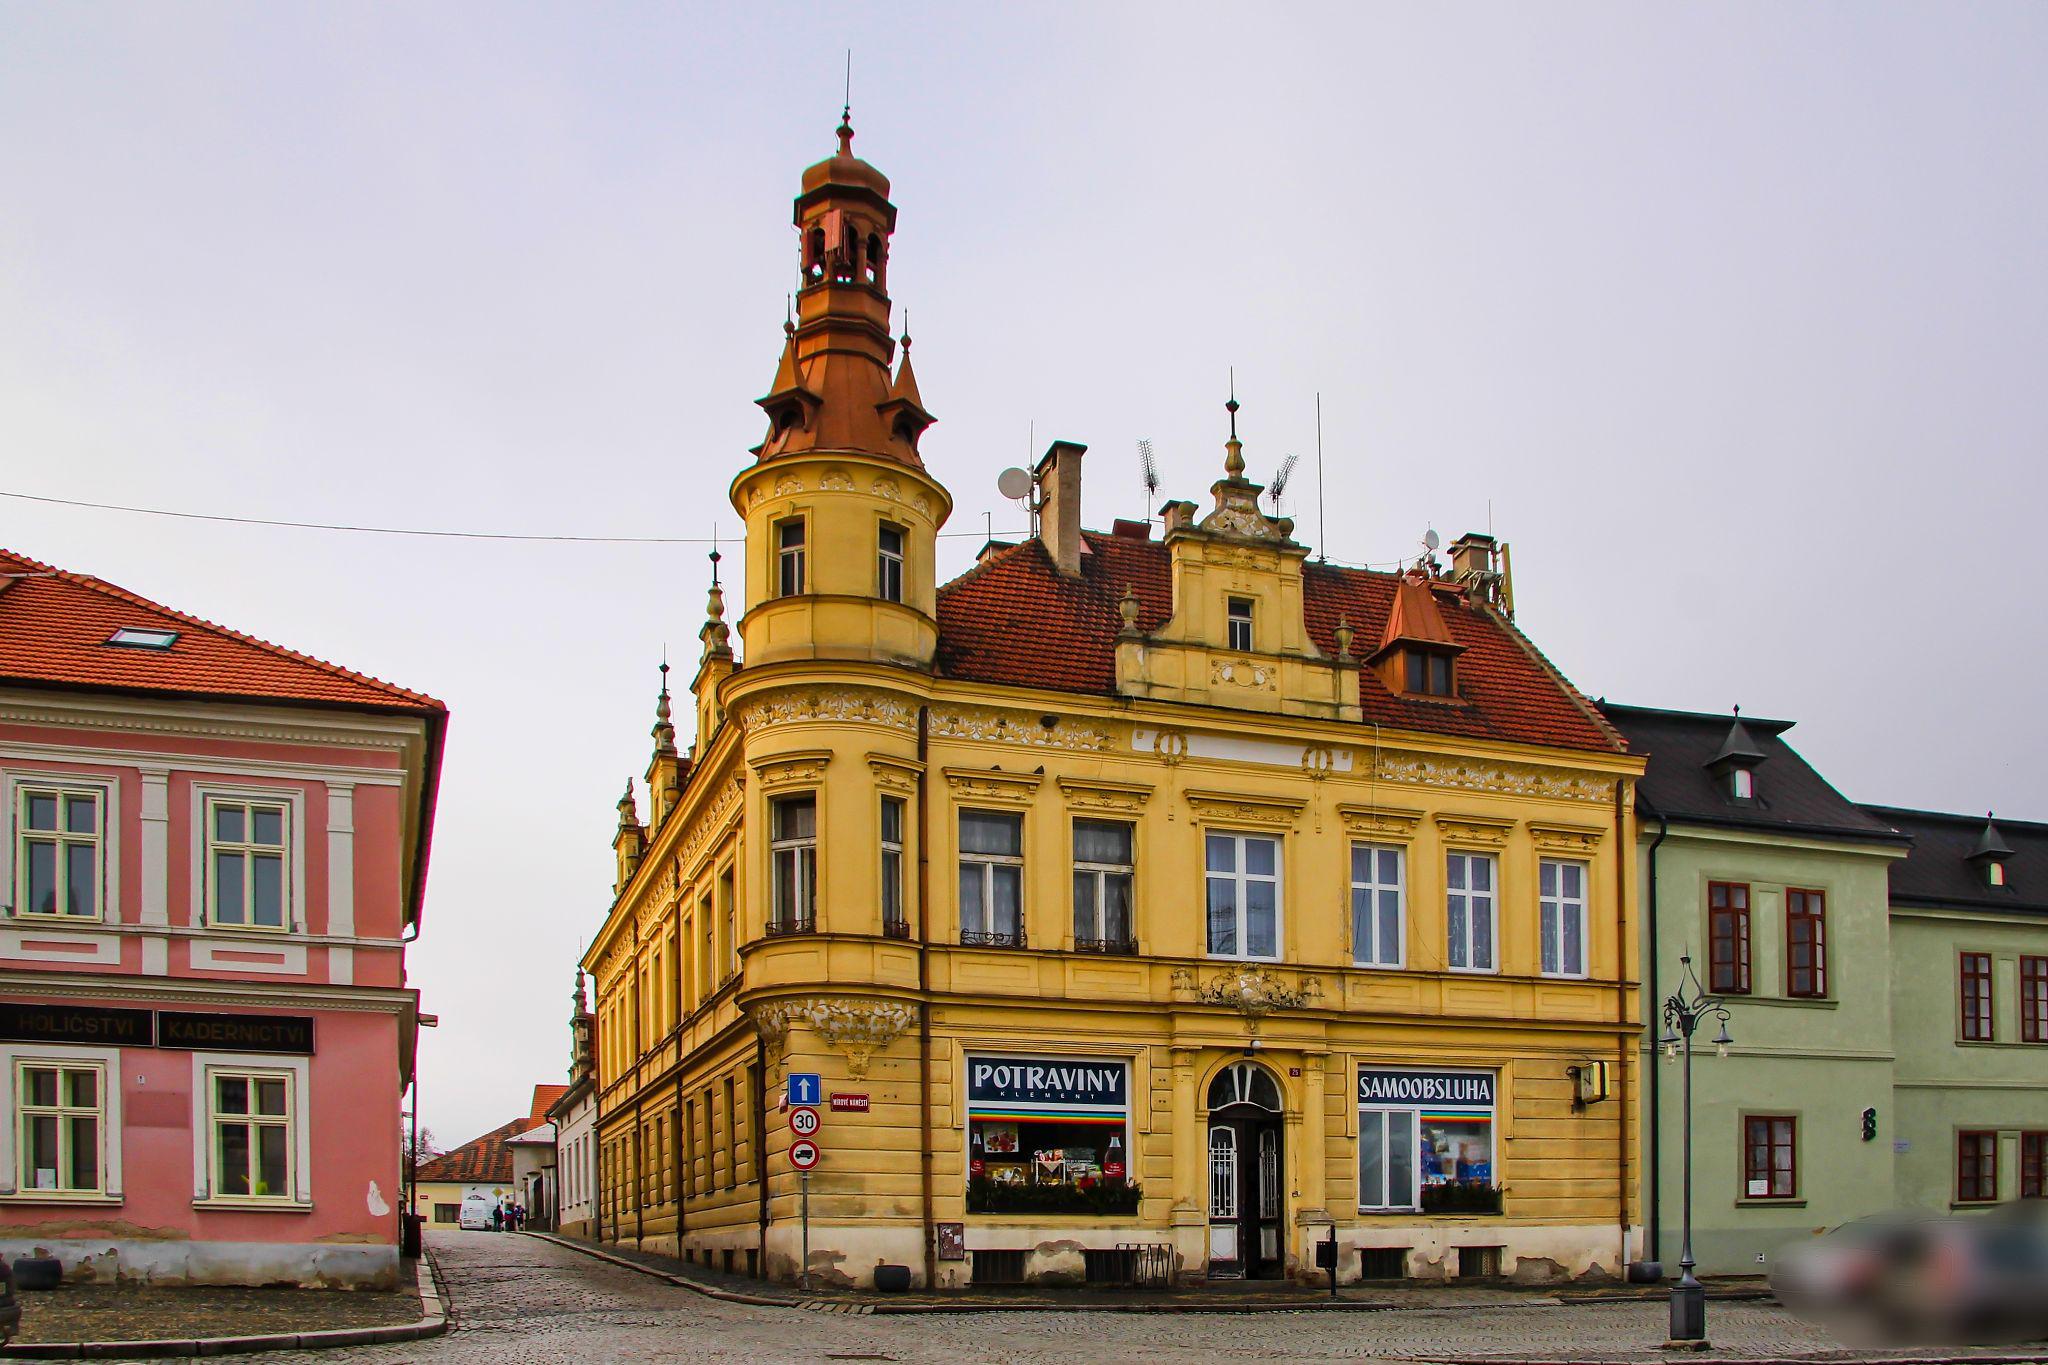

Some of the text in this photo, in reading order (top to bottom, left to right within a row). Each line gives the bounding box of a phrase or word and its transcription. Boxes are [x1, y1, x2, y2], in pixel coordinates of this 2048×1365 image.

[974, 1064, 1120, 1093] POTRAVINY
[1359, 1076, 1491, 1101] SAMOOBSLUHA
[1000, 1091, 1096, 1100] KLEMENT
[795, 1114, 814, 1129] 30
